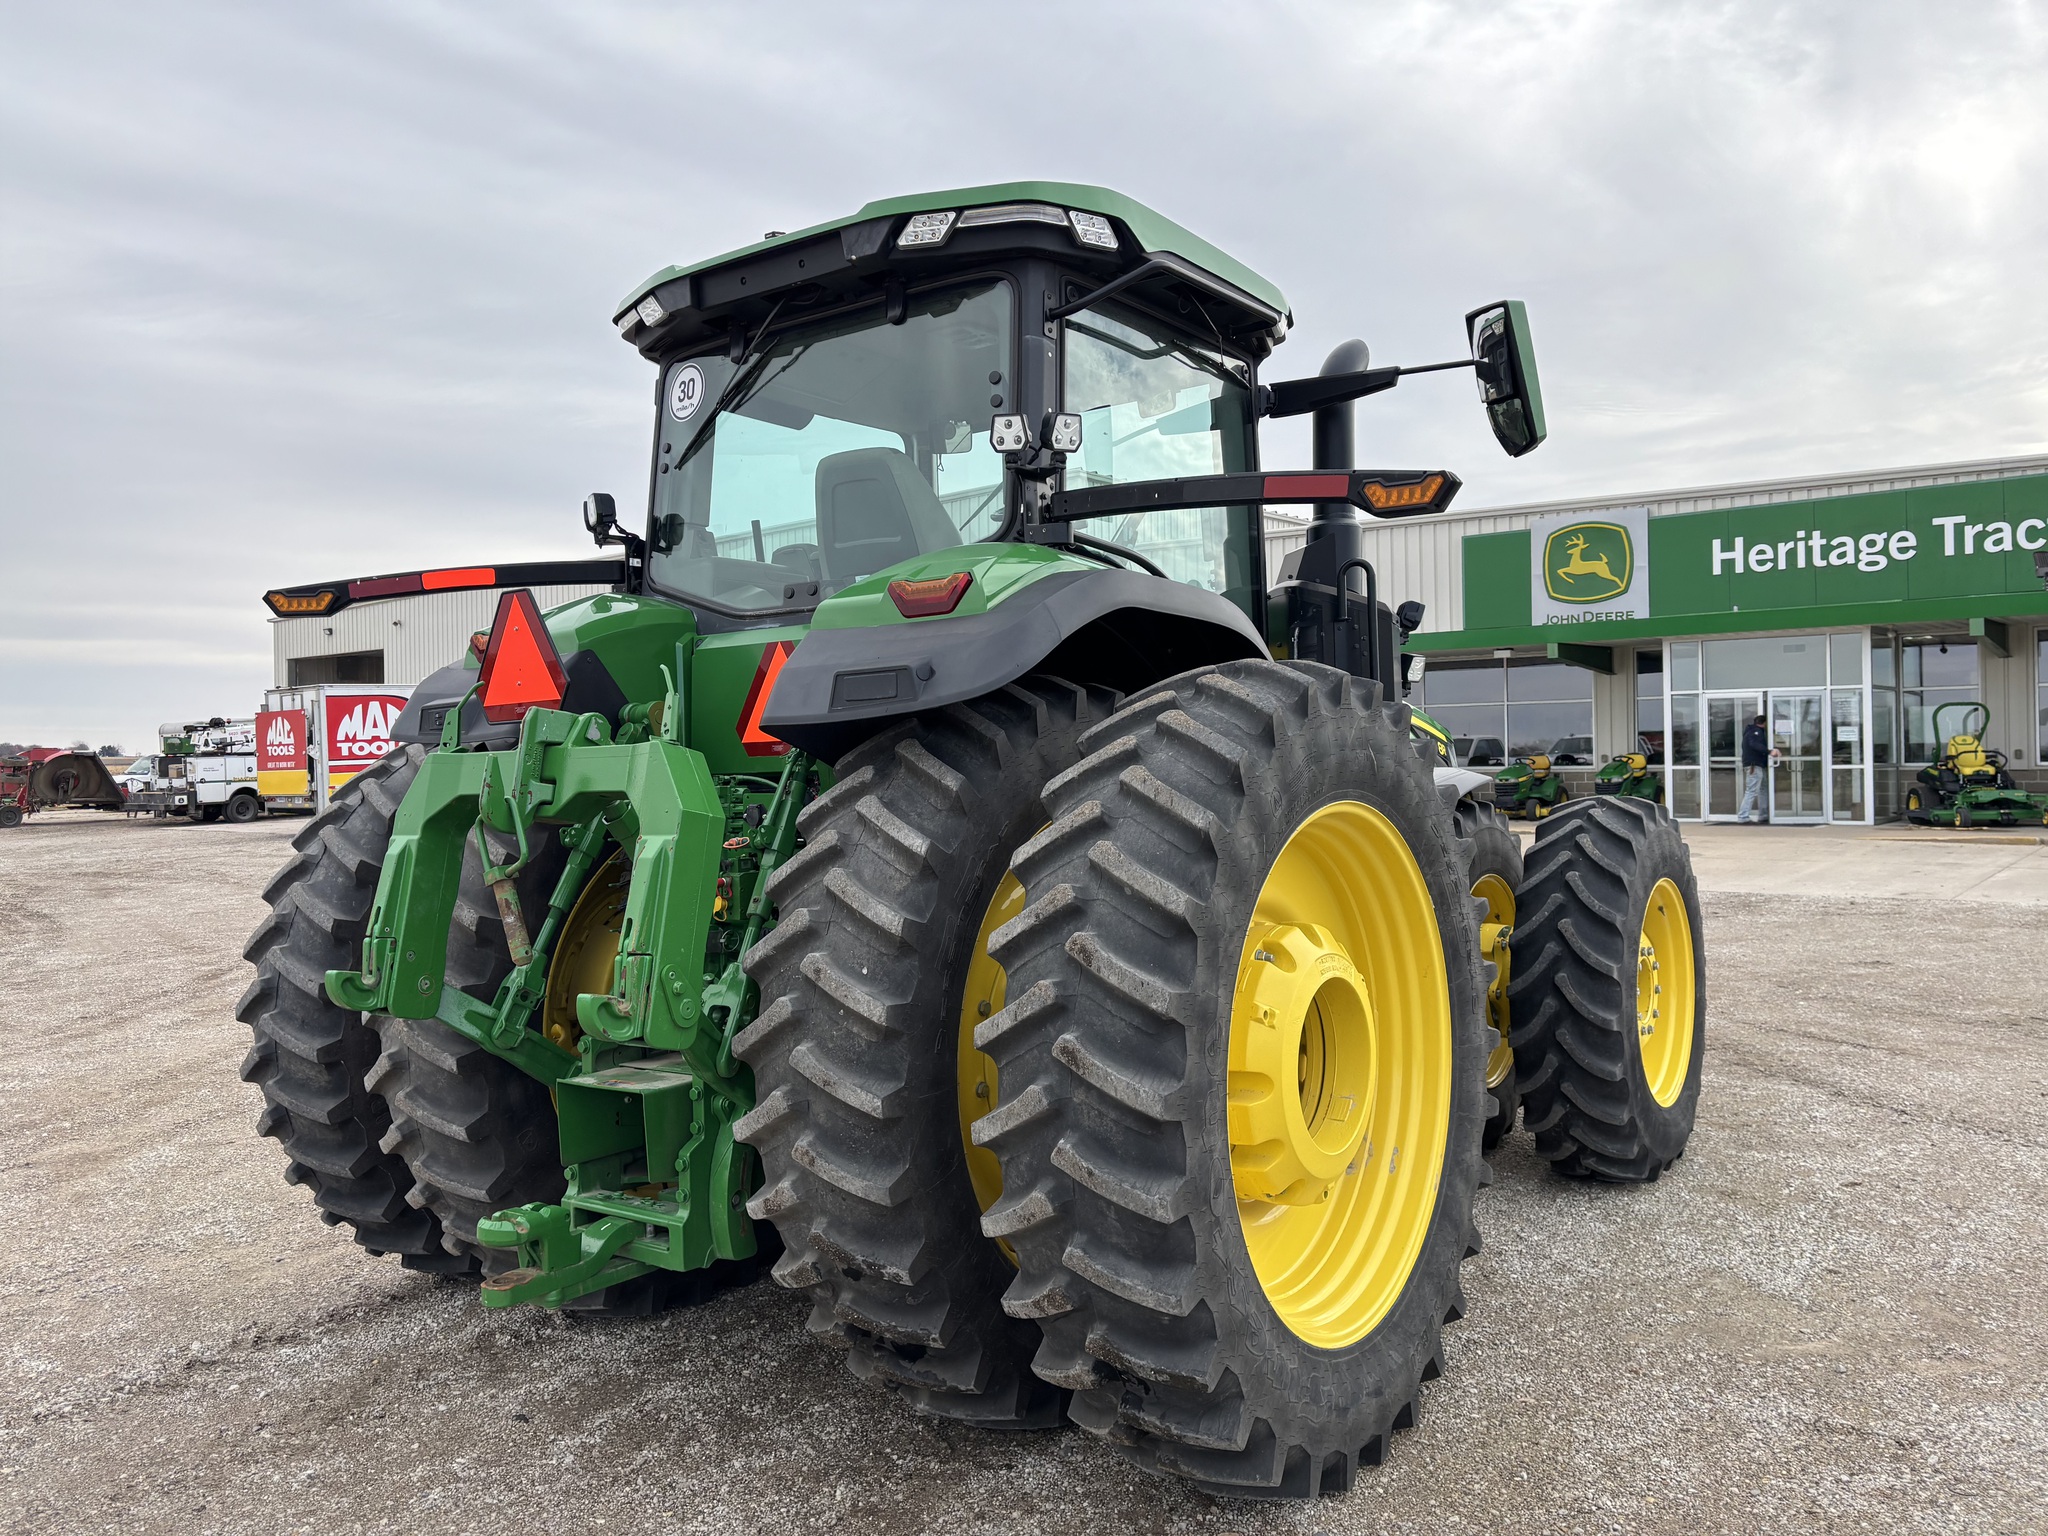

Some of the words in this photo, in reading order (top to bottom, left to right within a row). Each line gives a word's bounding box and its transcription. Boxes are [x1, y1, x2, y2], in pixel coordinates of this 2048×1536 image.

[678, 377, 695, 403] 30
[1711, 529, 1918, 576] Heritage
[1932, 514, 2048, 557] Trac
[1542, 614, 1580, 626] JOHN
[1583, 611, 1635, 623] DEERE
[266, 716, 295, 745] MAC
[266, 745, 295, 757] TOOLS
